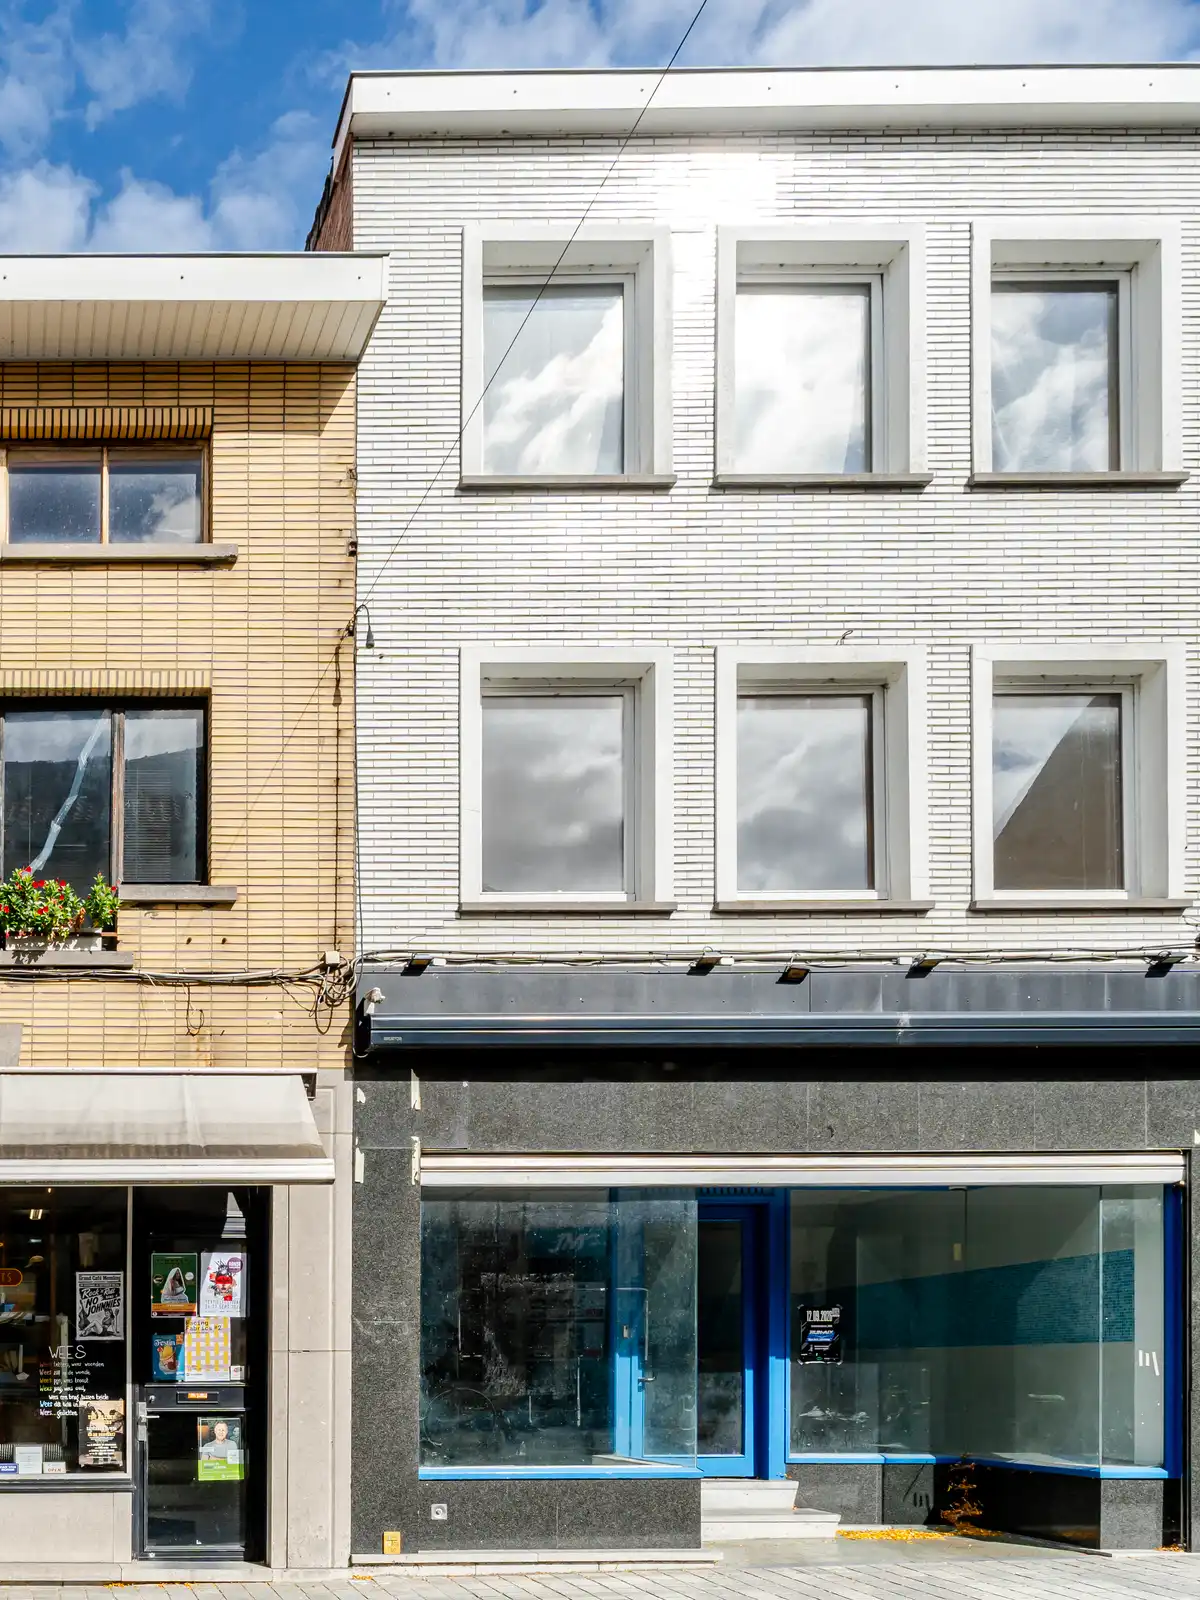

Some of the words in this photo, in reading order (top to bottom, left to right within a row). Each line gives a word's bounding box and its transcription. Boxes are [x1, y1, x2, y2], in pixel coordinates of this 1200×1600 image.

[85, 1296, 99, 1309] NO
[87, 1298, 121, 1318] JOHNNIES
[48, 1345, 87, 1360] WEES
